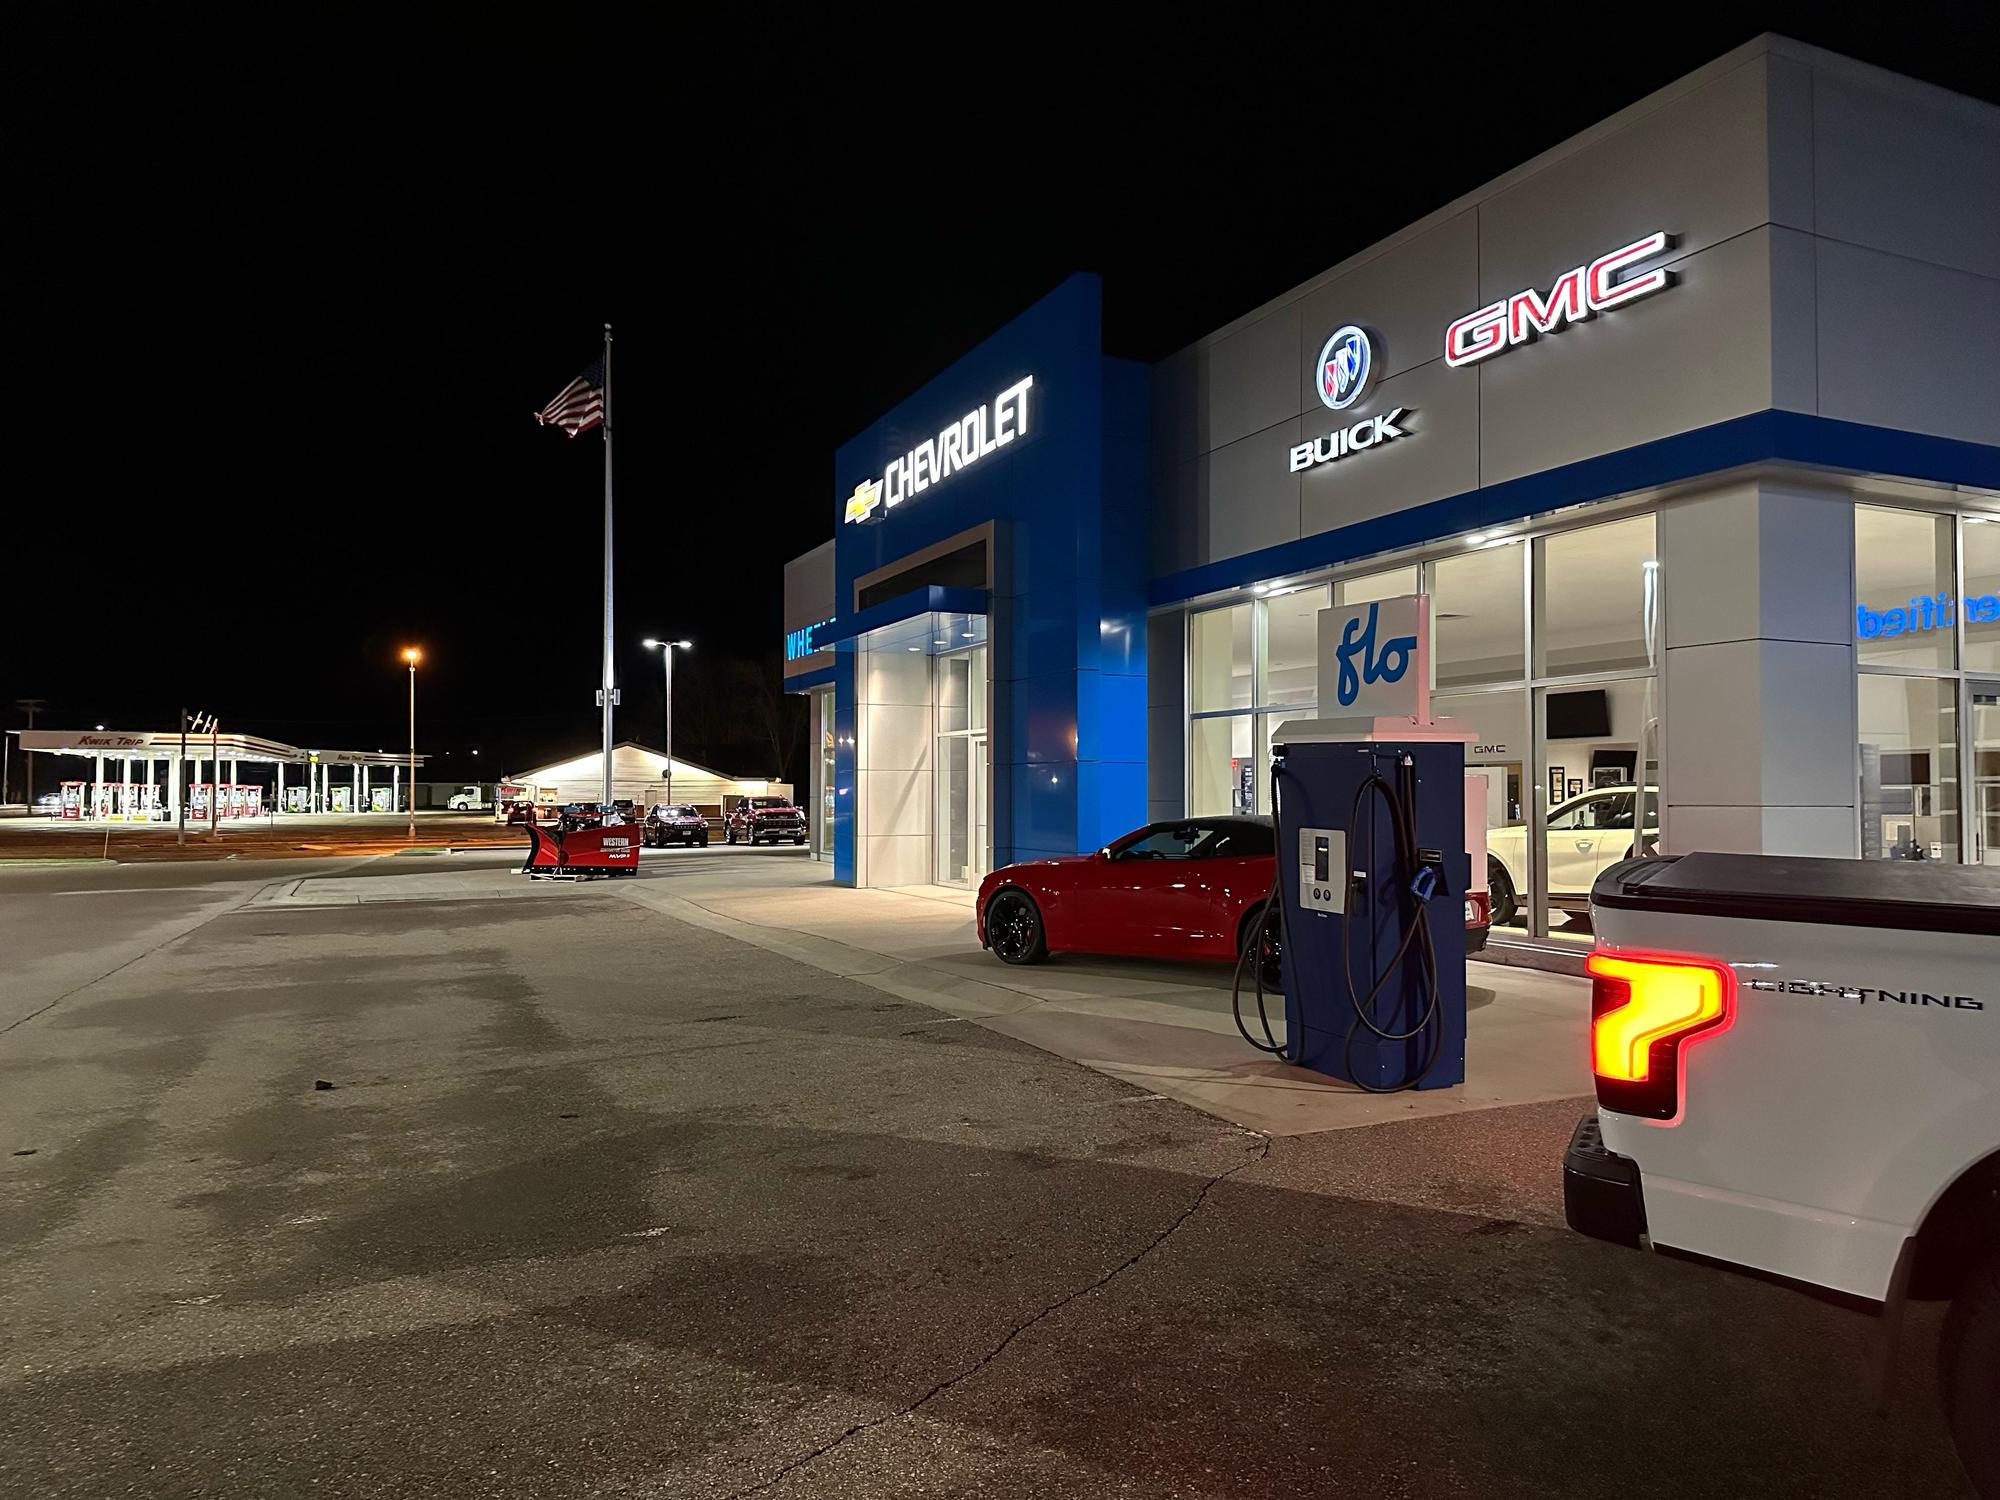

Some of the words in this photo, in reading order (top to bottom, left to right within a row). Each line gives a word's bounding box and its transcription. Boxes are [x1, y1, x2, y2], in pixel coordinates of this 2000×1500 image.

[1444, 230, 1667, 369] GMC
[885, 374, 1034, 509] CHEVROLET
[1289, 407, 1405, 474] BUICK
[1335, 602, 1417, 707] flo
[1474, 744, 1507, 754] GMC
[602, 837, 629, 846] WESTERN
[1751, 978, 1984, 1011] LIGHTNING
